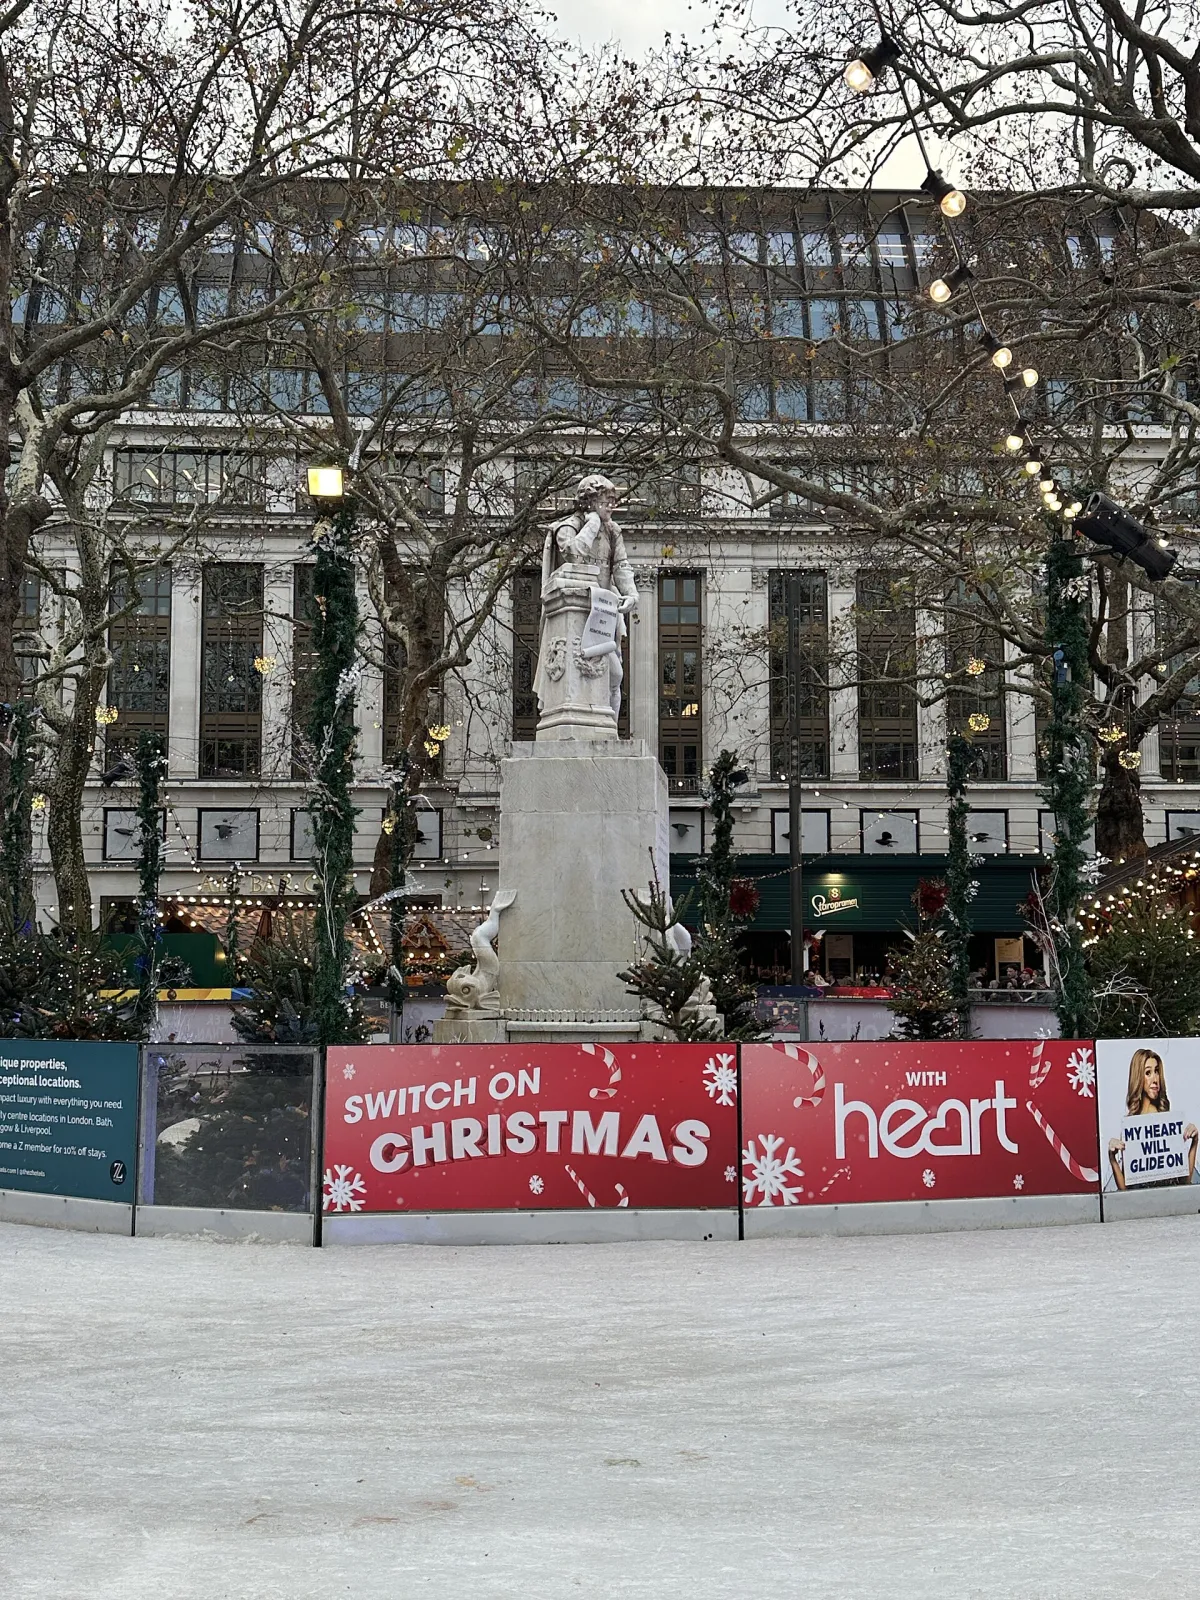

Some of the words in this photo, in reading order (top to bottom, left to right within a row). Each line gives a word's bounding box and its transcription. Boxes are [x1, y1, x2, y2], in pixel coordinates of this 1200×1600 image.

[590, 628, 612, 638] IGNORANCE
[811, 894, 860, 918] Staropramen
[20, 1058, 68, 1072] properties,
[39, 1074, 82, 1088] locations.
[905, 1071, 947, 1087] WITH
[17, 1094, 37, 1106] luxury
[38, 1096, 52, 1105] with
[53, 1097, 88, 1110] everything
[89, 1100, 102, 1110] you
[104, 1100, 124, 1110] need.
[344, 1077, 476, 1124] SWITCH
[488, 1066, 541, 1100] ON
[8, 1111, 28, 1121] centre
[29, 1112, 58, 1122] locations
[60, 1114, 66, 1123] in
[96, 1116, 114, 1128] Bath,
[834, 1080, 1019, 1160] heart
[14, 1124, 20, 1132] &
[20, 1124, 52, 1136] Liverpool.
[1124, 1126, 1142, 1142] MY
[1144, 1121, 1184, 1139] HEART
[18, 1141, 24, 1150] Z
[24, 1142, 52, 1153] member
[53, 1144, 62, 1154] for
[64, 1146, 76, 1156] 10%
[78, 1146, 88, 1156] off
[88, 1148, 108, 1160] stays.
[368, 1110, 712, 1174] CHRISTMAS
[1140, 1139, 1170, 1156] WILL
[1130, 1155, 1164, 1174] GLIDE
[1166, 1152, 1184, 1168] ON
